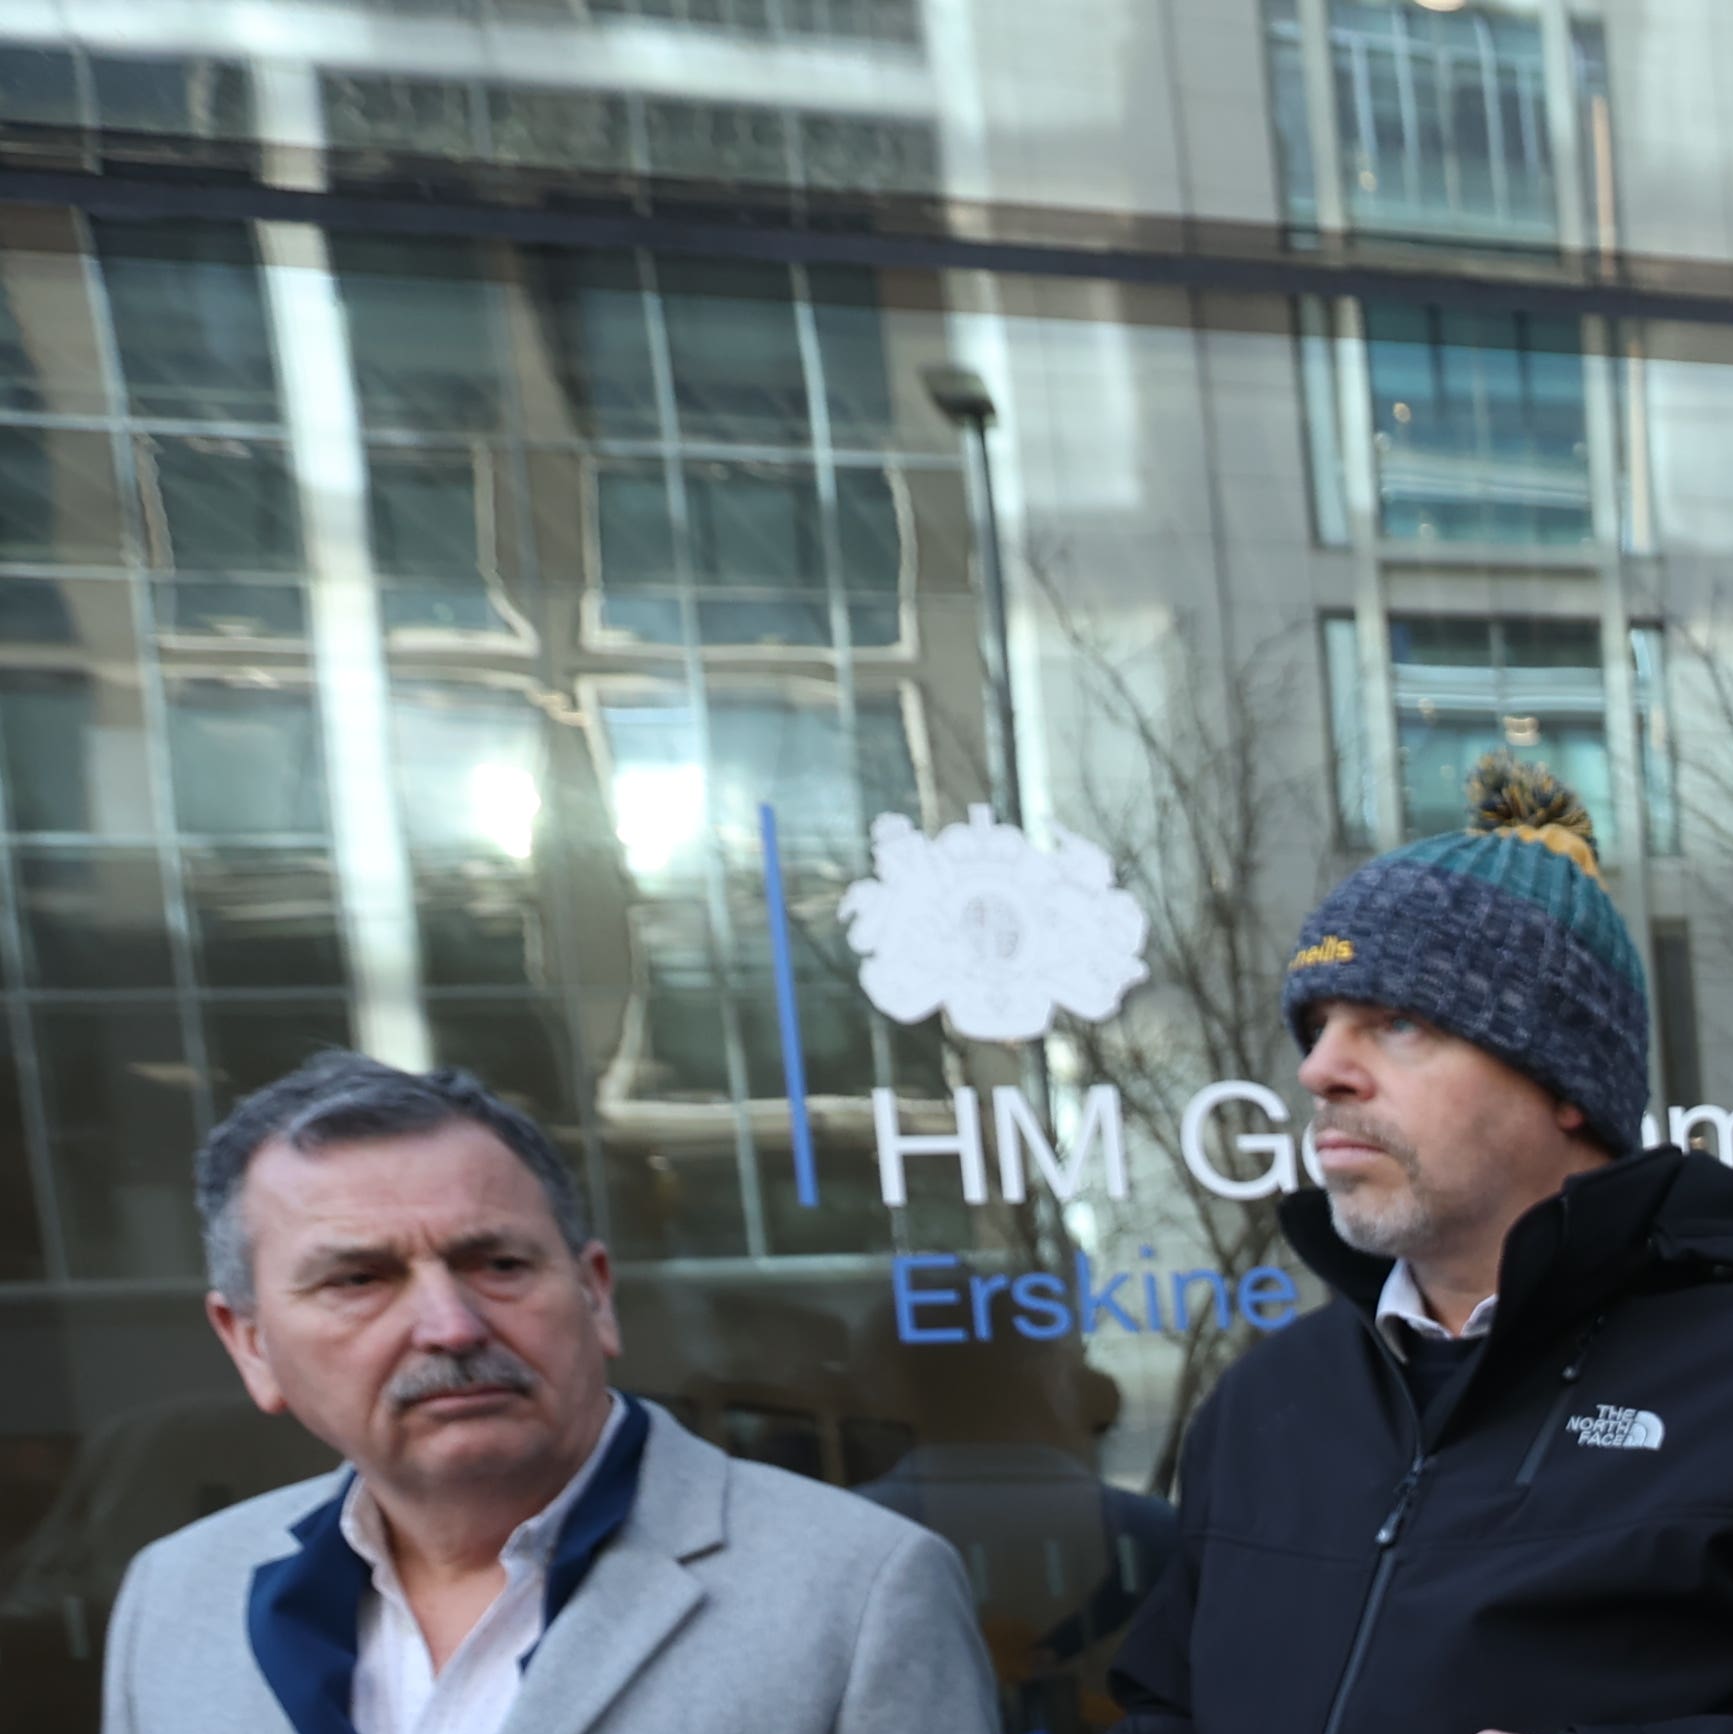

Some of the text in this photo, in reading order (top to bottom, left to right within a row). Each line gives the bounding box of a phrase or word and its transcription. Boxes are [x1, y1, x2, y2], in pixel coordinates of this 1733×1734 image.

[871, 1083, 1130, 1207] HM
[891, 1245, 1298, 1344] Erskine
[1596, 1404, 1637, 1421] THE
[1565, 1415, 1634, 1435] NORTH
[1577, 1431, 1625, 1447] FACE
